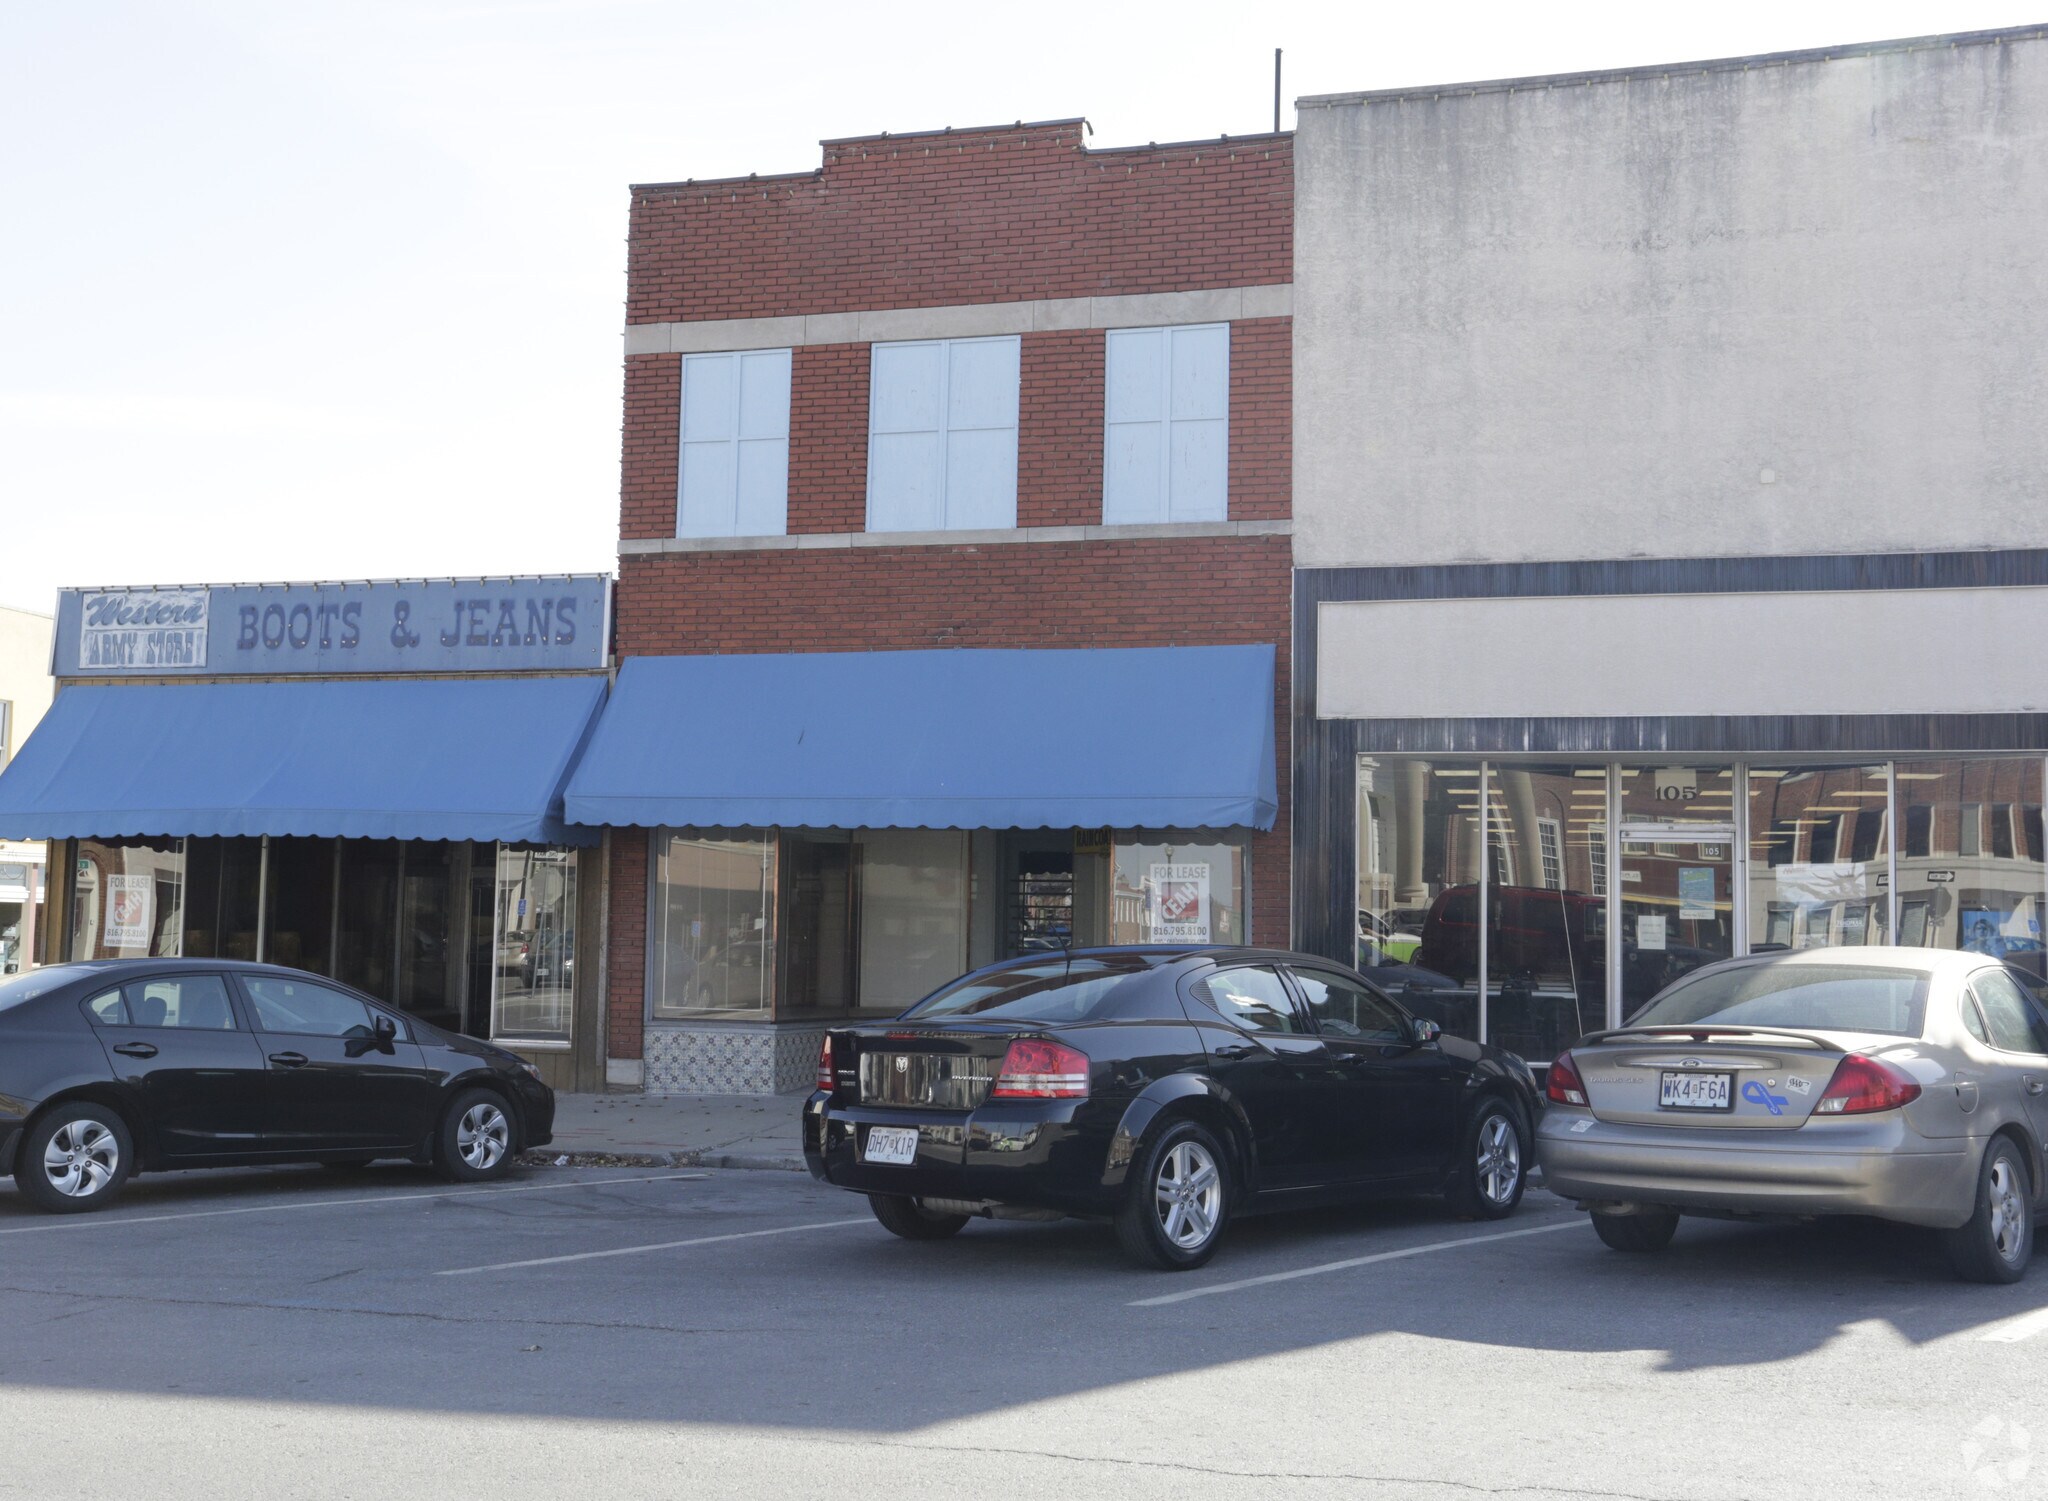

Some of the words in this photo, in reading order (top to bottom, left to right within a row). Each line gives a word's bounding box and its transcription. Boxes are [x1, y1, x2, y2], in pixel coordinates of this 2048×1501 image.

[86, 595, 206, 627] Western
[236, 601, 362, 651] BOOTS
[389, 600, 420, 649] &
[439, 596, 578, 648] JEANS
[89, 632, 138, 666] ARMY
[147, 630, 194, 665] STORE
[1655, 786, 1697, 801] 105
[1705, 847, 1720, 856] 105
[110, 877, 126, 888] FOR
[127, 878, 150, 889] LEASE
[1154, 867, 1173, 879] FOR
[1177, 867, 1207, 879] LEASE
[114, 891, 142, 922] CEAH
[1162, 882, 1200, 920] CEAH
[1153, 926, 1207, 936] 816.795.8100
[1663, 1079, 1691, 1099] WK4
[1698, 1080, 1727, 1100] F6A
